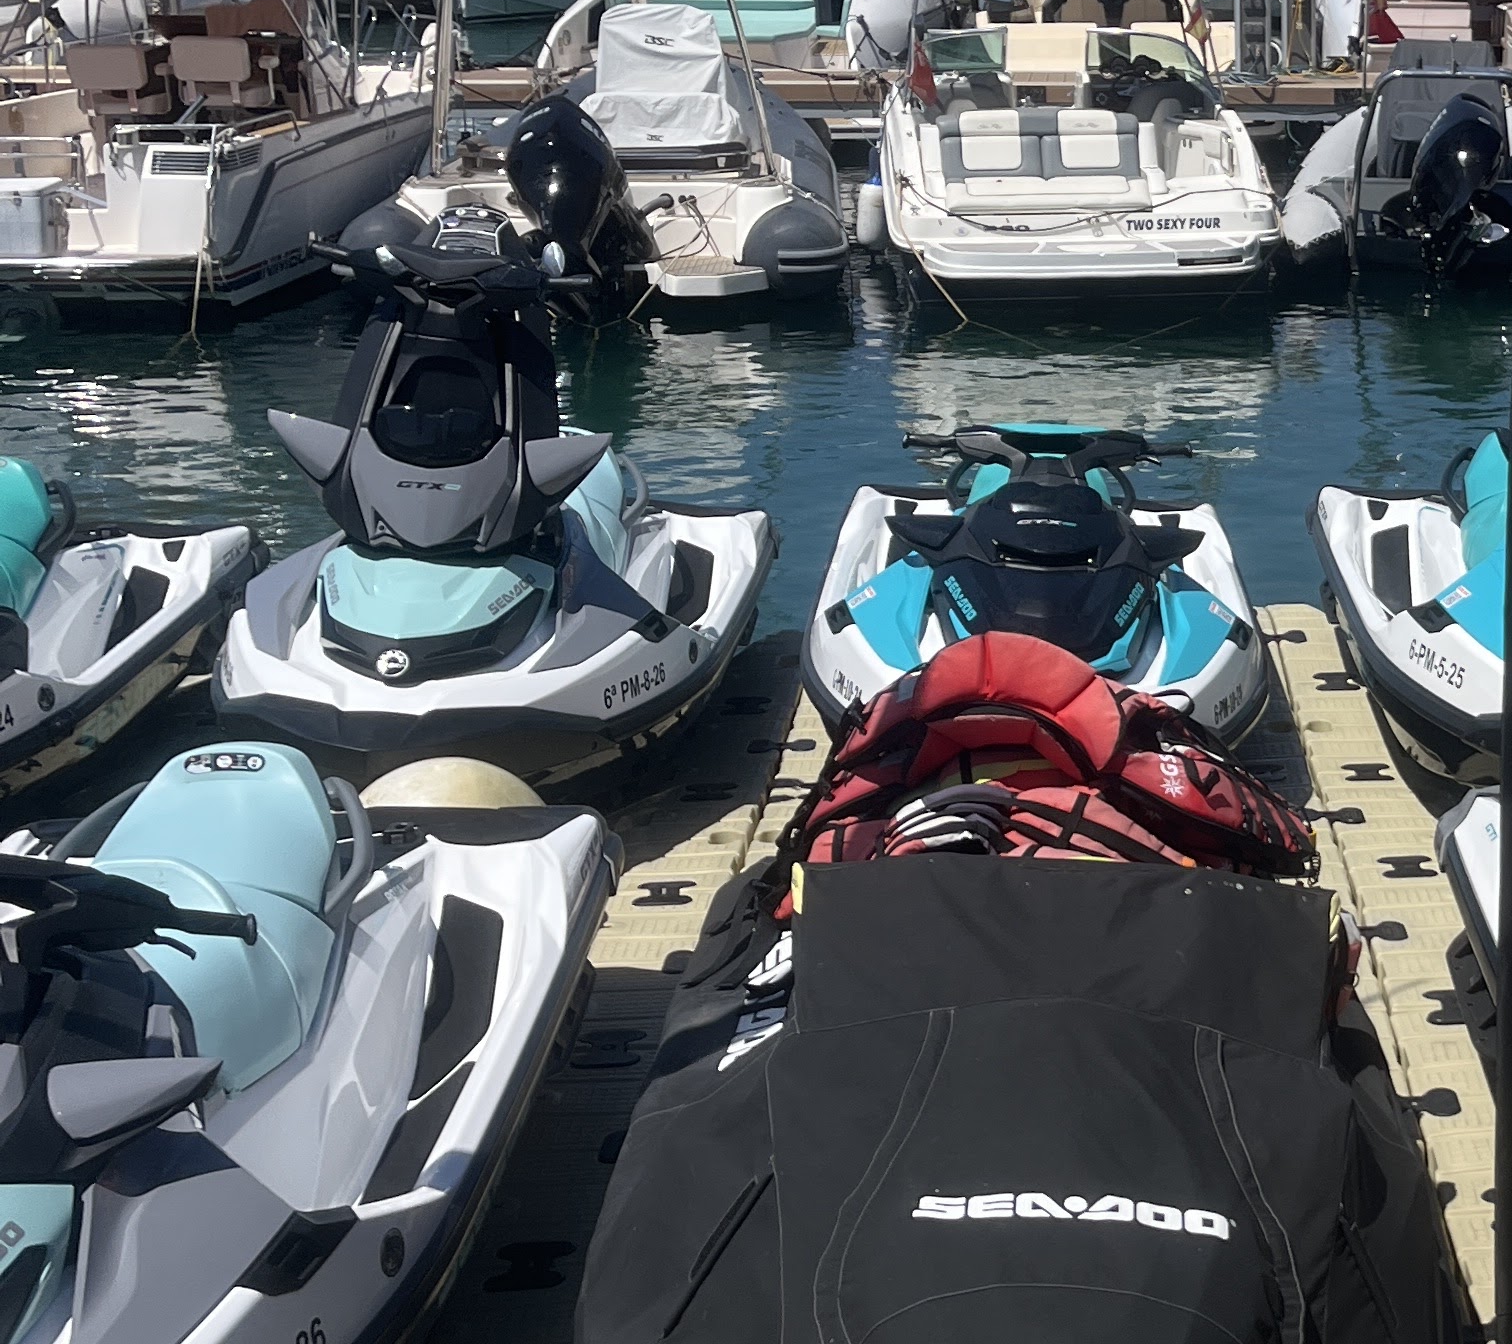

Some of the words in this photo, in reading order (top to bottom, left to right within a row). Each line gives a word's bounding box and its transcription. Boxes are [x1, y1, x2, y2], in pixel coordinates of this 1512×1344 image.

[1126, 219, 1154, 232] TWO
[1156, 218, 1187, 230] SEXY
[1189, 217, 1221, 229] FOUR
[620, 662, 666, 702] PM-8-26
[1408, 638, 1466, 689] 6-PM-5-25
